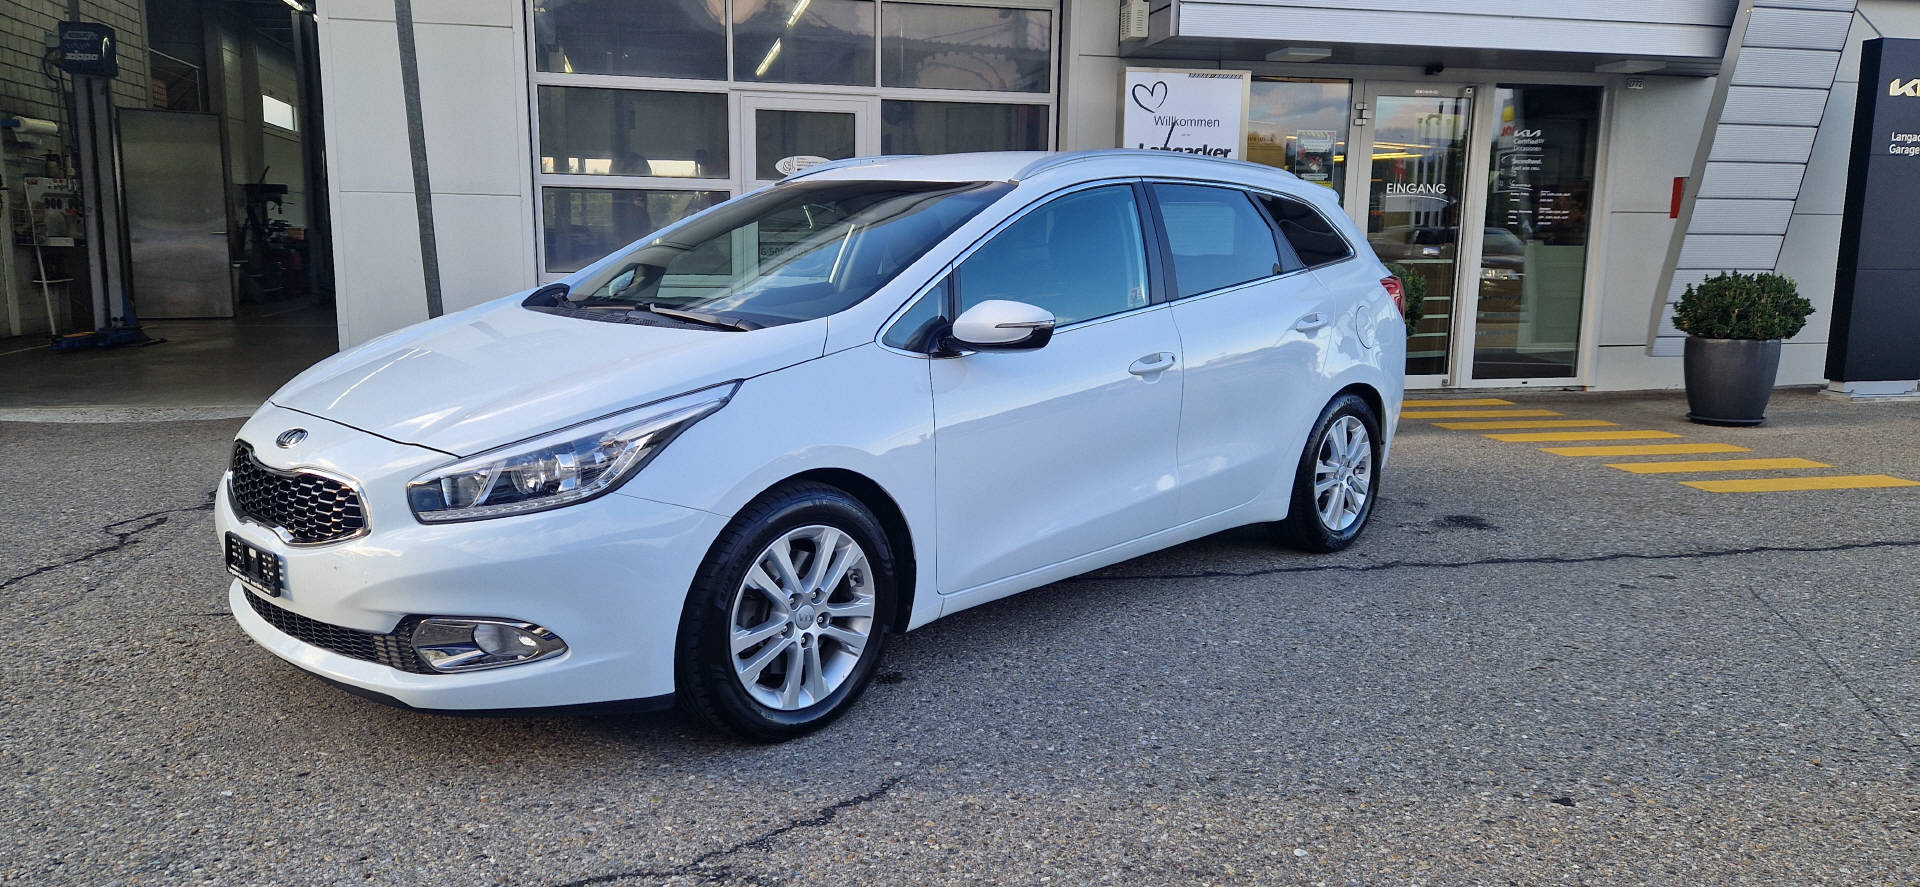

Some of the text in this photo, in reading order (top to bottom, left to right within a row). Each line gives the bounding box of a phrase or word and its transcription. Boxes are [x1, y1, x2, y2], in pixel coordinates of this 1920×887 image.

[1154, 115, 1220, 127] Willkommen
[1139, 143, 1232, 158] acker
[1889, 143, 1920, 156] Garage
[1386, 182, 1447, 194] EINGANG
